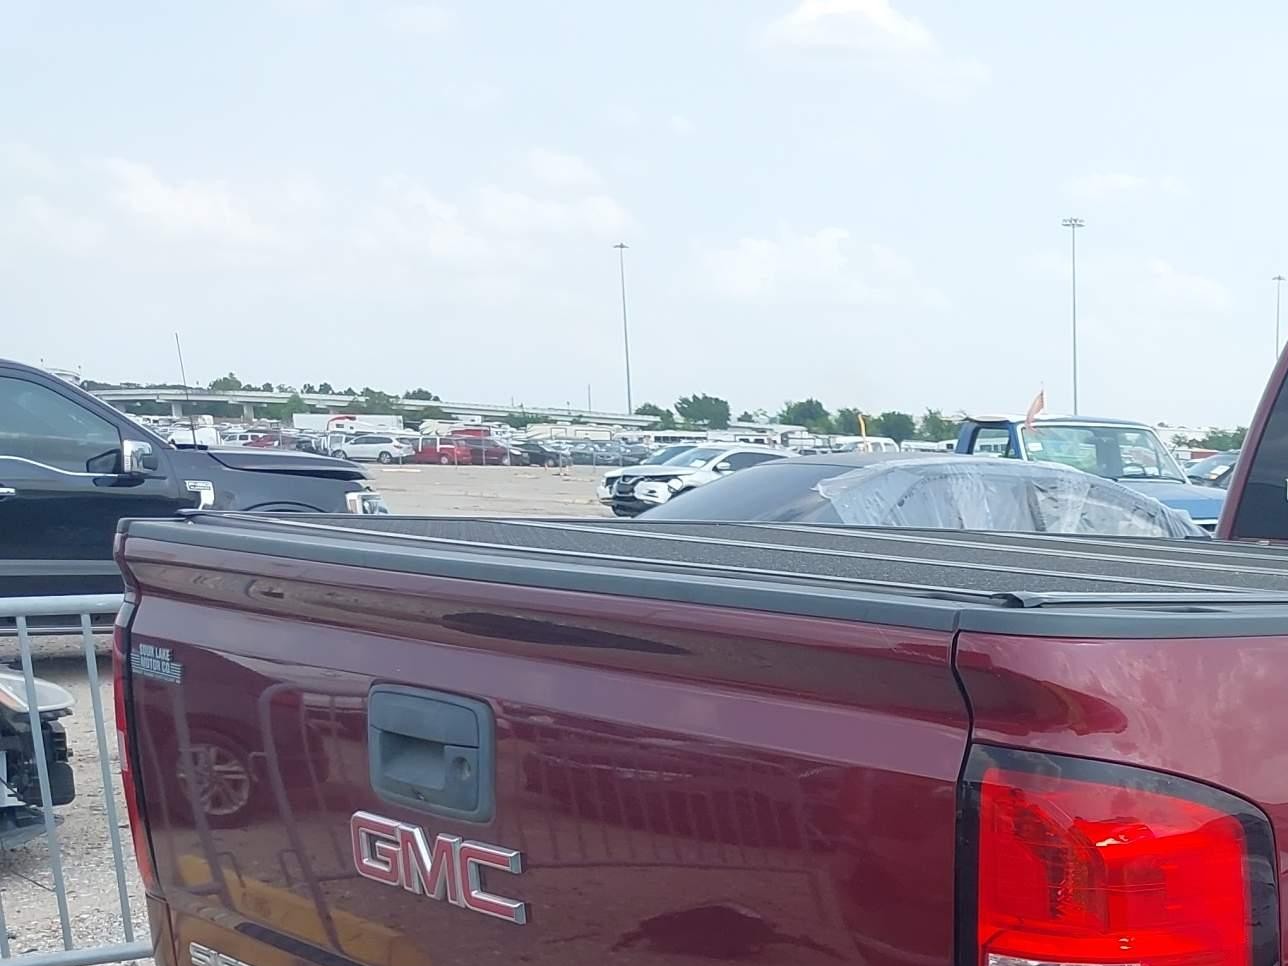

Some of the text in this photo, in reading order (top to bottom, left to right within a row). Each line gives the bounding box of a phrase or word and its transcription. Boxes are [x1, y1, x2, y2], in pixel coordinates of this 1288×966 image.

[155, 647, 170, 661] LAKE
[140, 656, 161, 671] MOTOR
[351, 810, 527, 925] GMC
